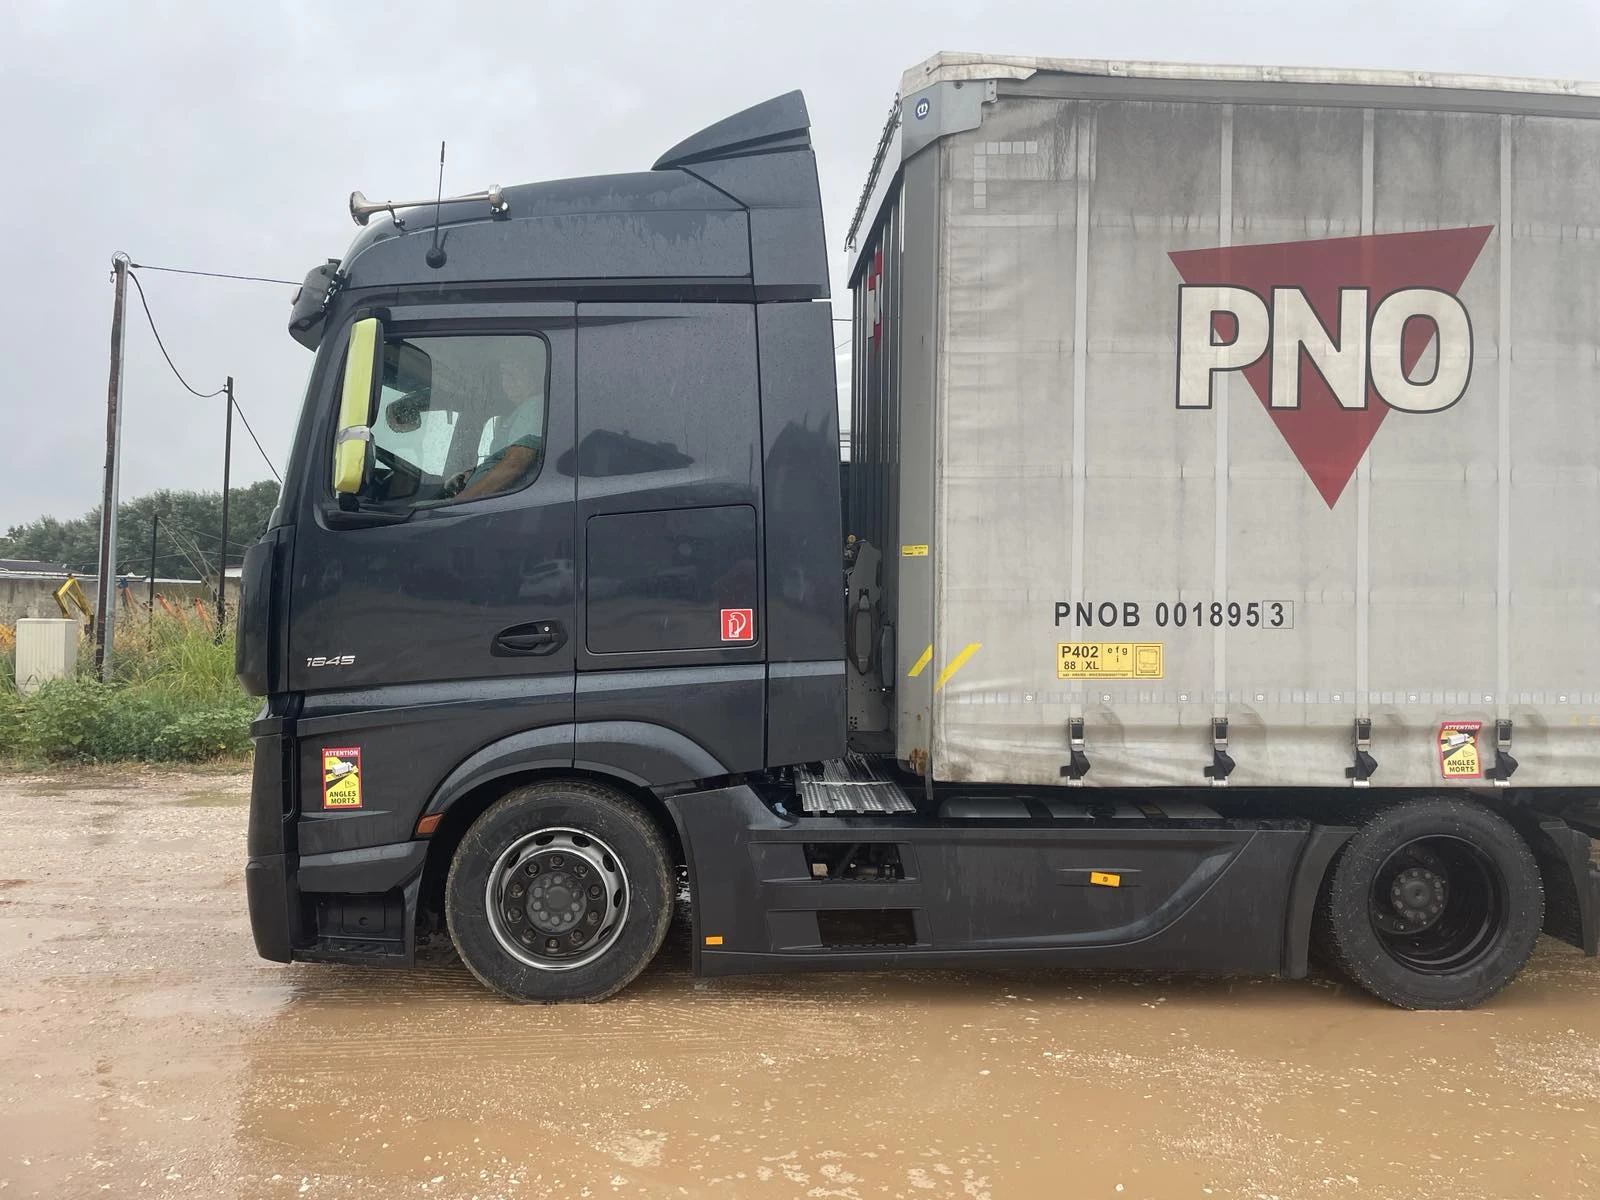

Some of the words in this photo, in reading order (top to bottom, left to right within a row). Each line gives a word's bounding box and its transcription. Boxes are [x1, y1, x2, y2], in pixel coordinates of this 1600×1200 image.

[1176, 284, 1474, 414] PNO
[1054, 601, 1140, 627] PNOB
[1061, 645, 1099, 658] P402
[306, 655, 356, 667] 1845
[1063, 660, 1076, 670] 88
[1085, 660, 1100, 670] XL
[329, 790, 357, 798] ANGLES
[330, 797, 356, 805] MORTS
